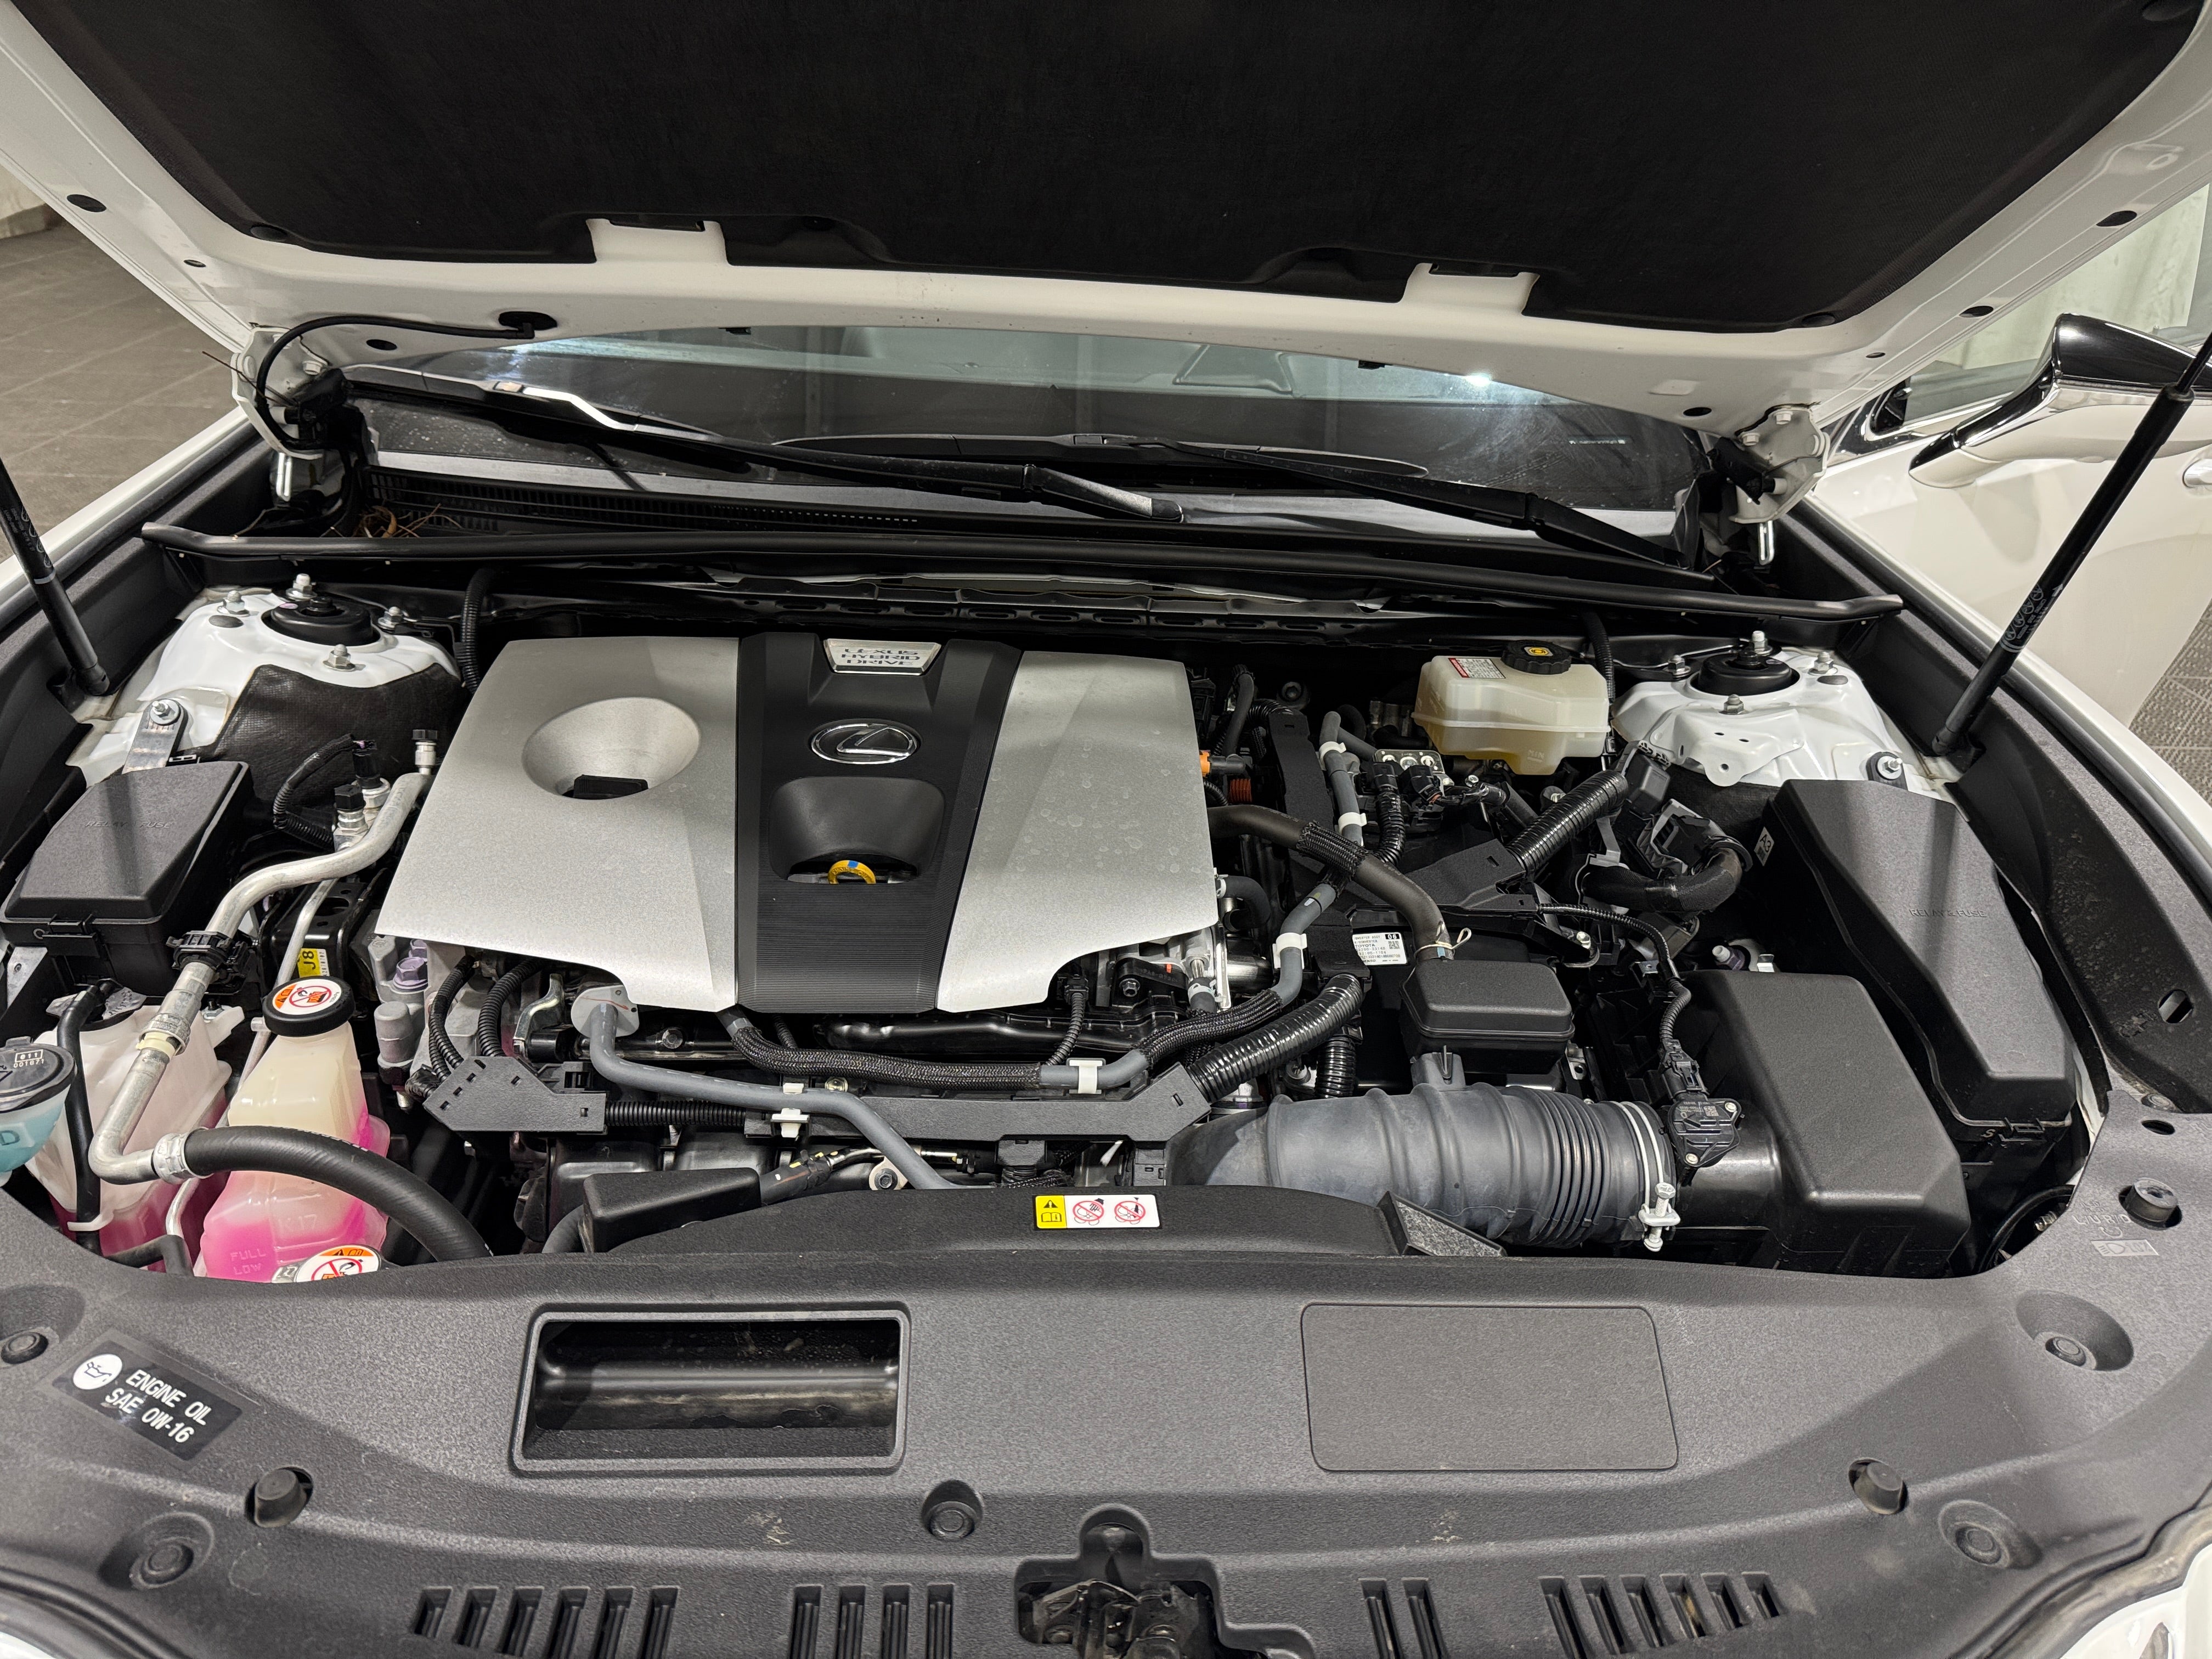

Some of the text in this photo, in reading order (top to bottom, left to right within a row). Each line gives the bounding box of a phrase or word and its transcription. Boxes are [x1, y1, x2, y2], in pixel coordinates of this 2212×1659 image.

[1759, 834, 1771, 853] A3
[1957, 909, 1988, 918] FUSE
[230, 1248, 267, 1262] FULL
[233, 1263, 263, 1276] LOW
[105, 1388, 144, 1414] SAE
[126, 1369, 213, 1426] ENGINE OIL
